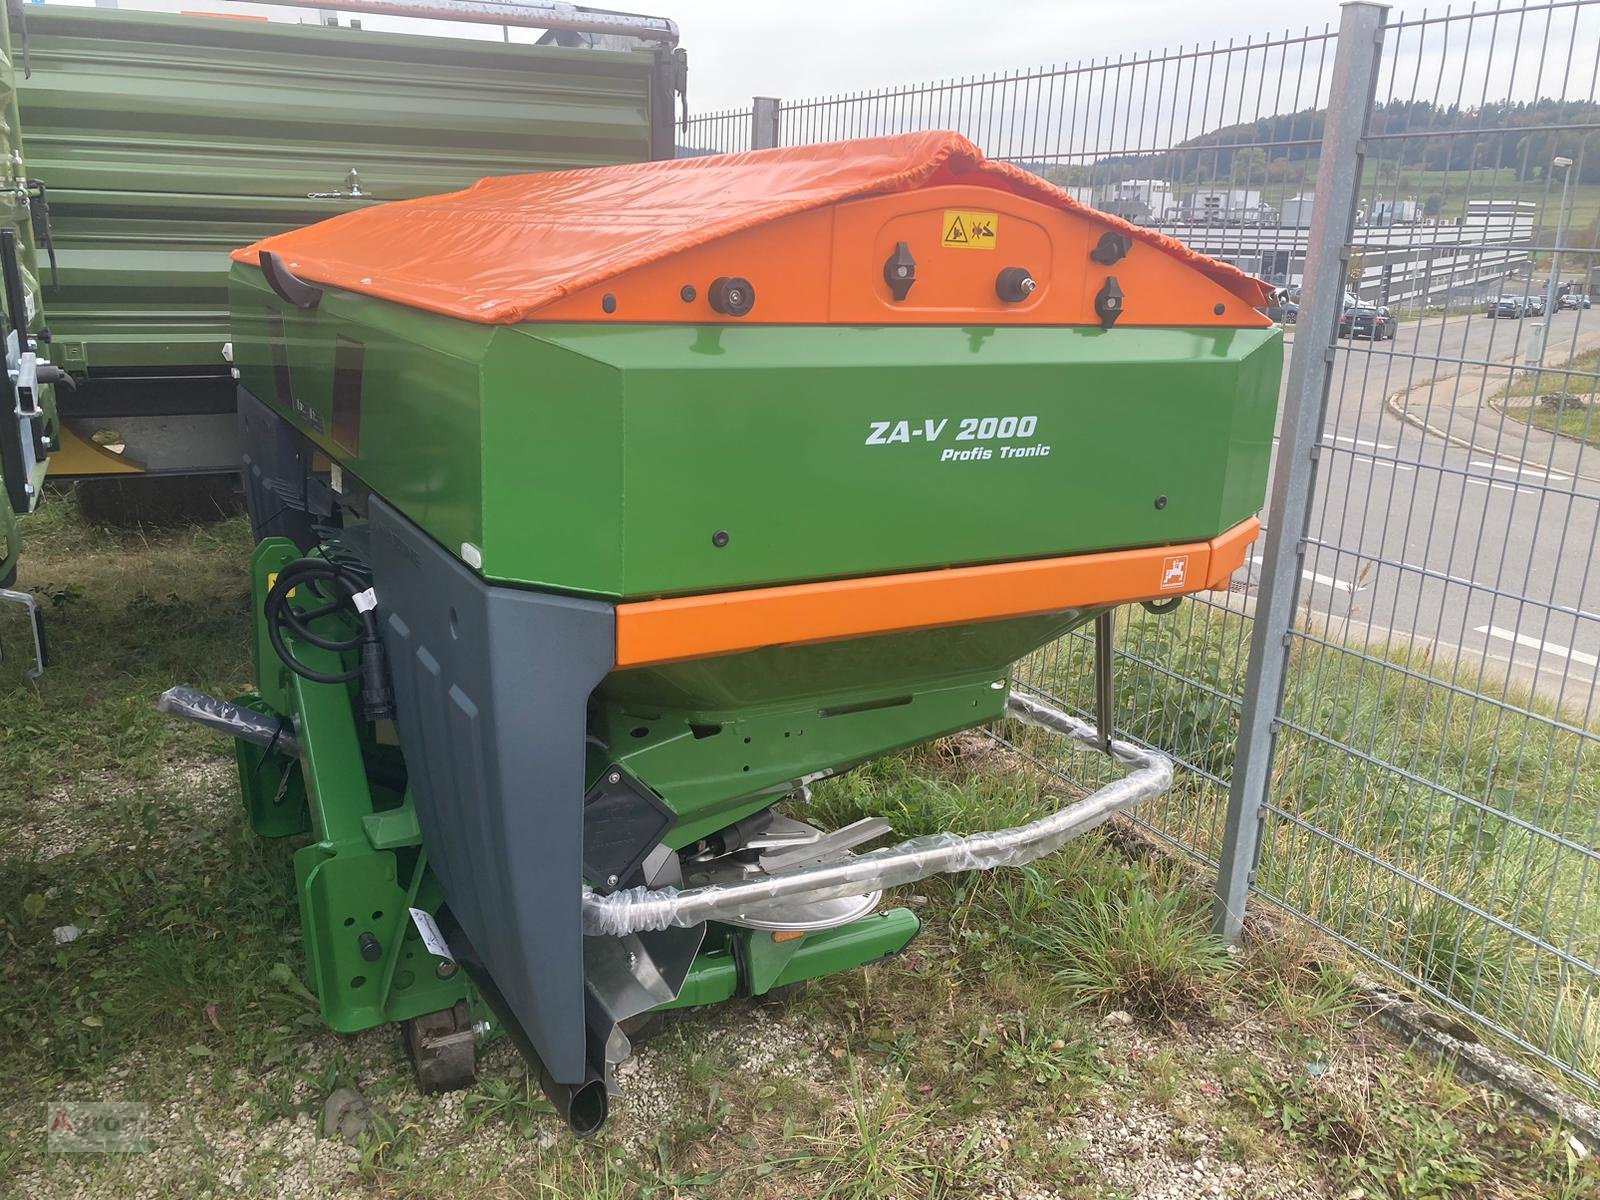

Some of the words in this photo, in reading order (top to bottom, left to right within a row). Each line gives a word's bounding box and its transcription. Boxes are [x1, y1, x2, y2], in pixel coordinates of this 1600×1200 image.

[865, 418, 948, 445] ZA-V
[955, 416, 1038, 441] 2000
[941, 447, 992, 461] Profis
[1000, 443, 1050, 458] Tronic
